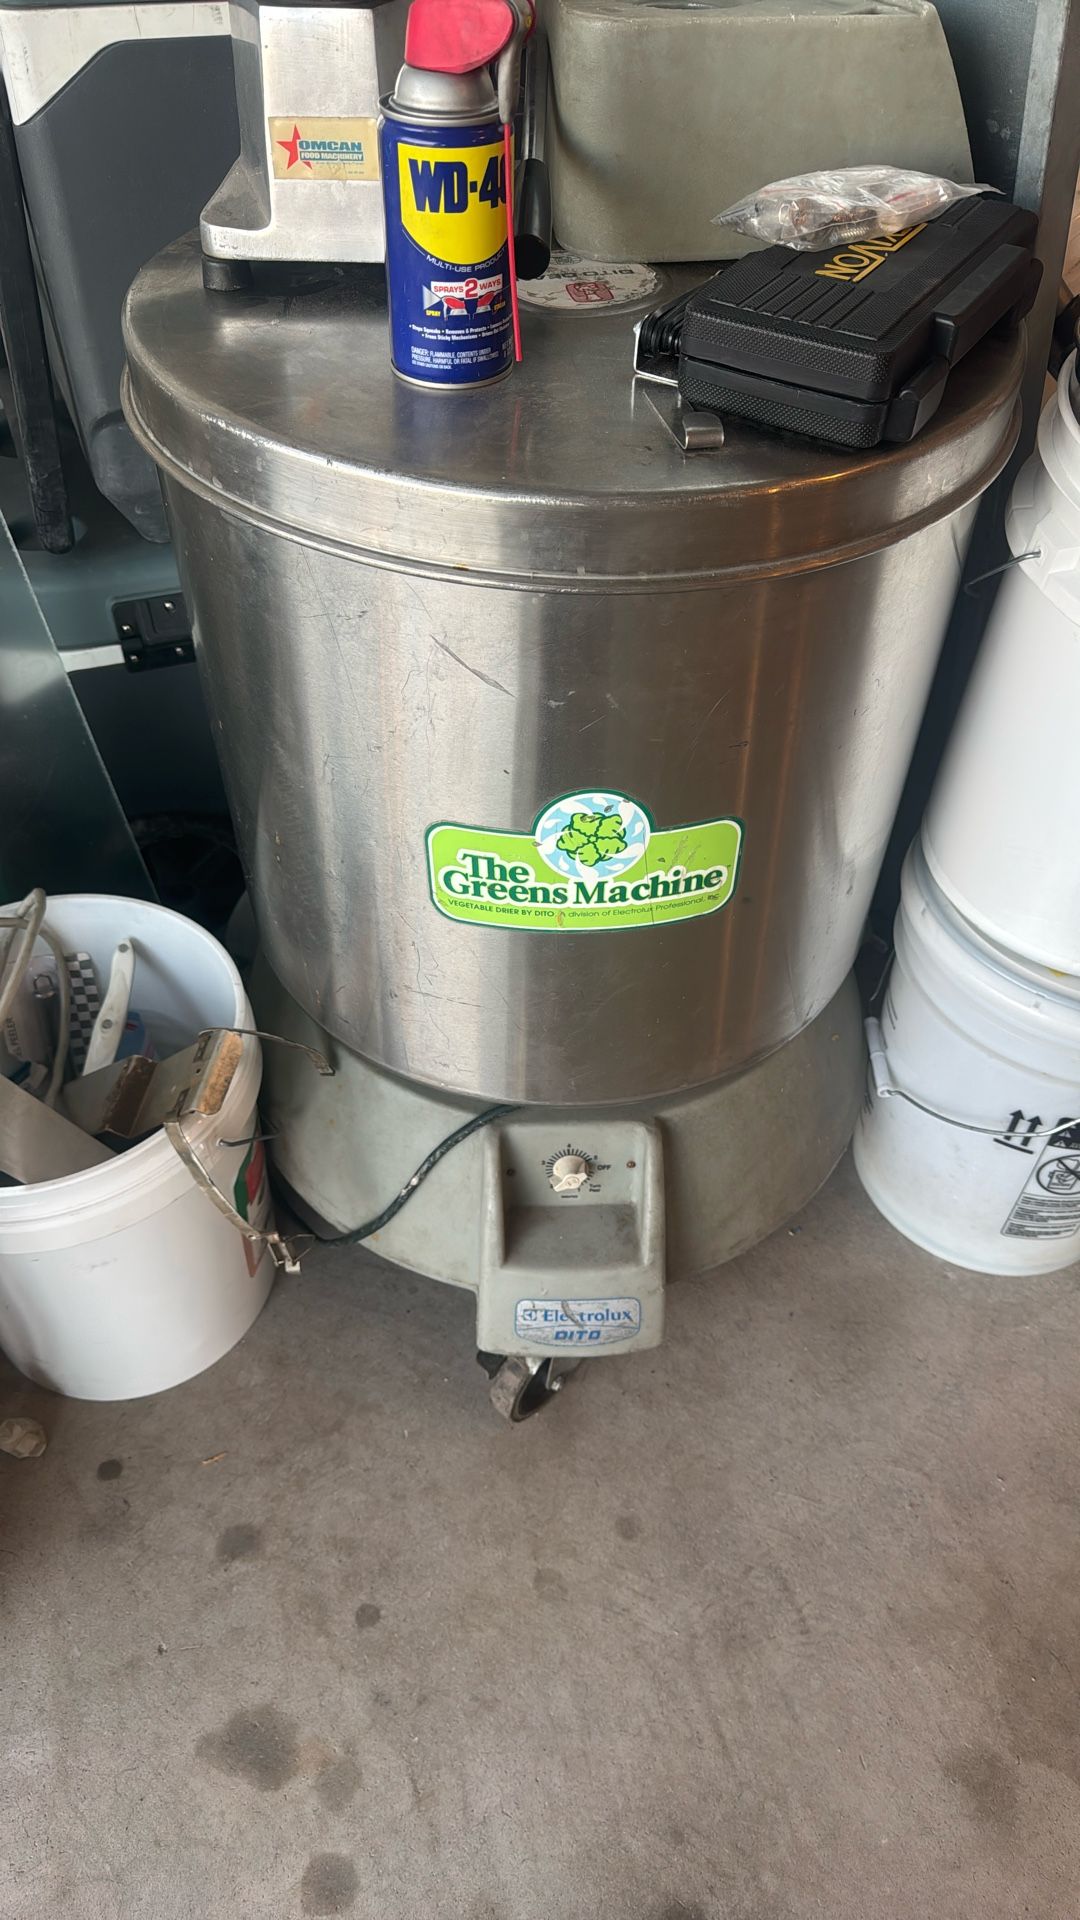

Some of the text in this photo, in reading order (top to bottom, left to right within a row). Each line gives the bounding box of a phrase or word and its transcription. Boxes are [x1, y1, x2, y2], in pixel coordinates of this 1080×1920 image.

[299, 140, 362, 151] OMCAN
[321, 153, 363, 161] MACHINERY
[426, 254, 472, 273] MULTI-USE
[433, 279, 501, 298] SPRAYS 2 WAYS
[462, 853, 529, 883] The
[443, 869, 723, 904] Greens Machine
[448, 899, 494, 912] VEGETABLE
[495, 906, 519, 915] DRIER
[602, 909, 612, 917] of
[544, 1309, 632, 1322] Eletrolux
[554, 1331, 601, 1340] DITO
